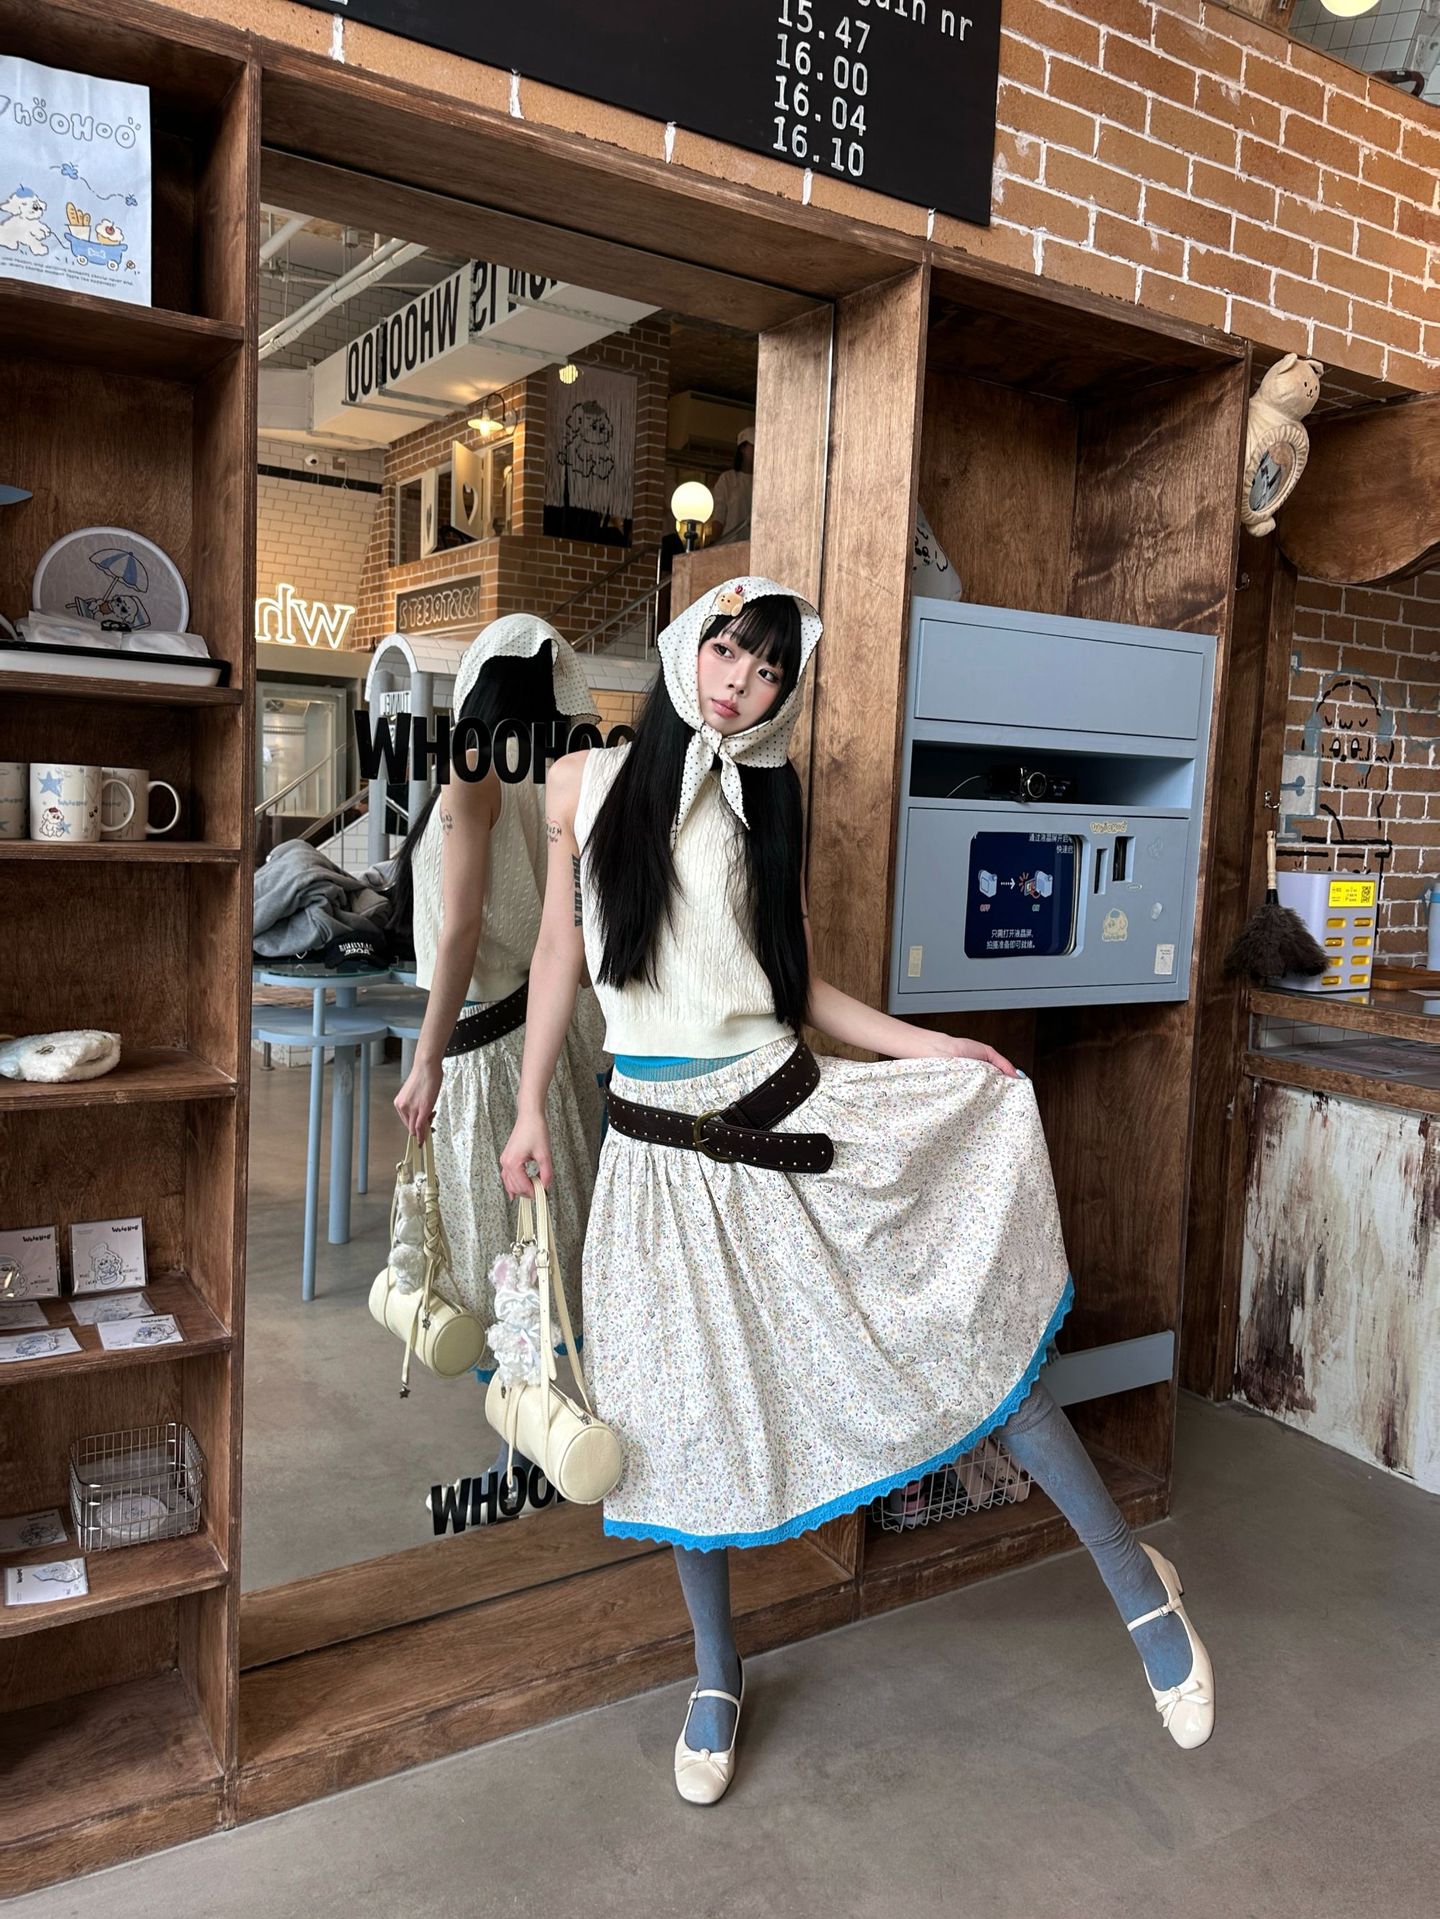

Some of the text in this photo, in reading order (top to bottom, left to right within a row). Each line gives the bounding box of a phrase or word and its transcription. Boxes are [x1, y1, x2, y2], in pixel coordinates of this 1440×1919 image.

[778, 0, 871, 53] 15.47
[941, 9, 973, 41] nr
[776, 33, 868, 96] 16.00
[774, 75, 867, 136] 16.04
[772, 116, 865, 177] 16.10
[431, 1464, 568, 1536] WHOO
